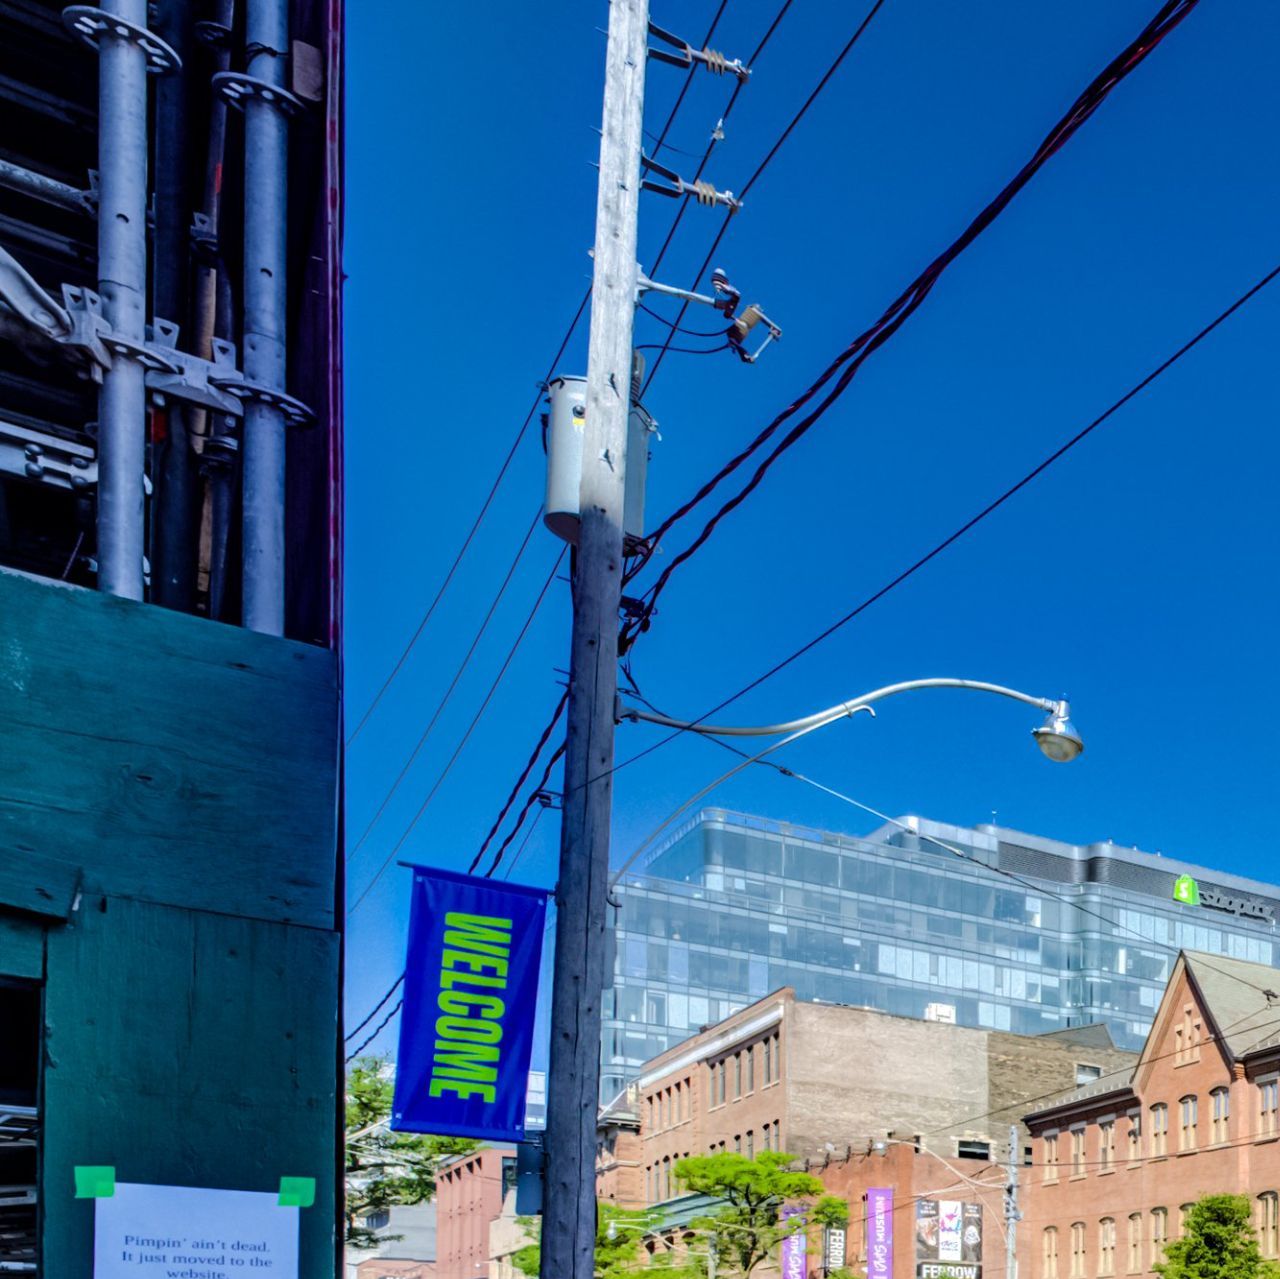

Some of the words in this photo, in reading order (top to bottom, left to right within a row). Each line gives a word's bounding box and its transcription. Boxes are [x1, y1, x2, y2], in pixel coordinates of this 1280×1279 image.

[429, 912, 512, 1103] WELCOME
[875, 1195, 886, 1242] MUSEUM
[124, 1234, 187, 1250] Pimpin'
[191, 1238, 227, 1250] ain't
[231, 1239, 271, 1252] dead.
[121, 1251, 133, 1262] It
[137, 1251, 168, 1265] just
[172, 1254, 226, 1266] moved
[230, 1257, 245, 1267] to
[249, 1256, 273, 1268] the
